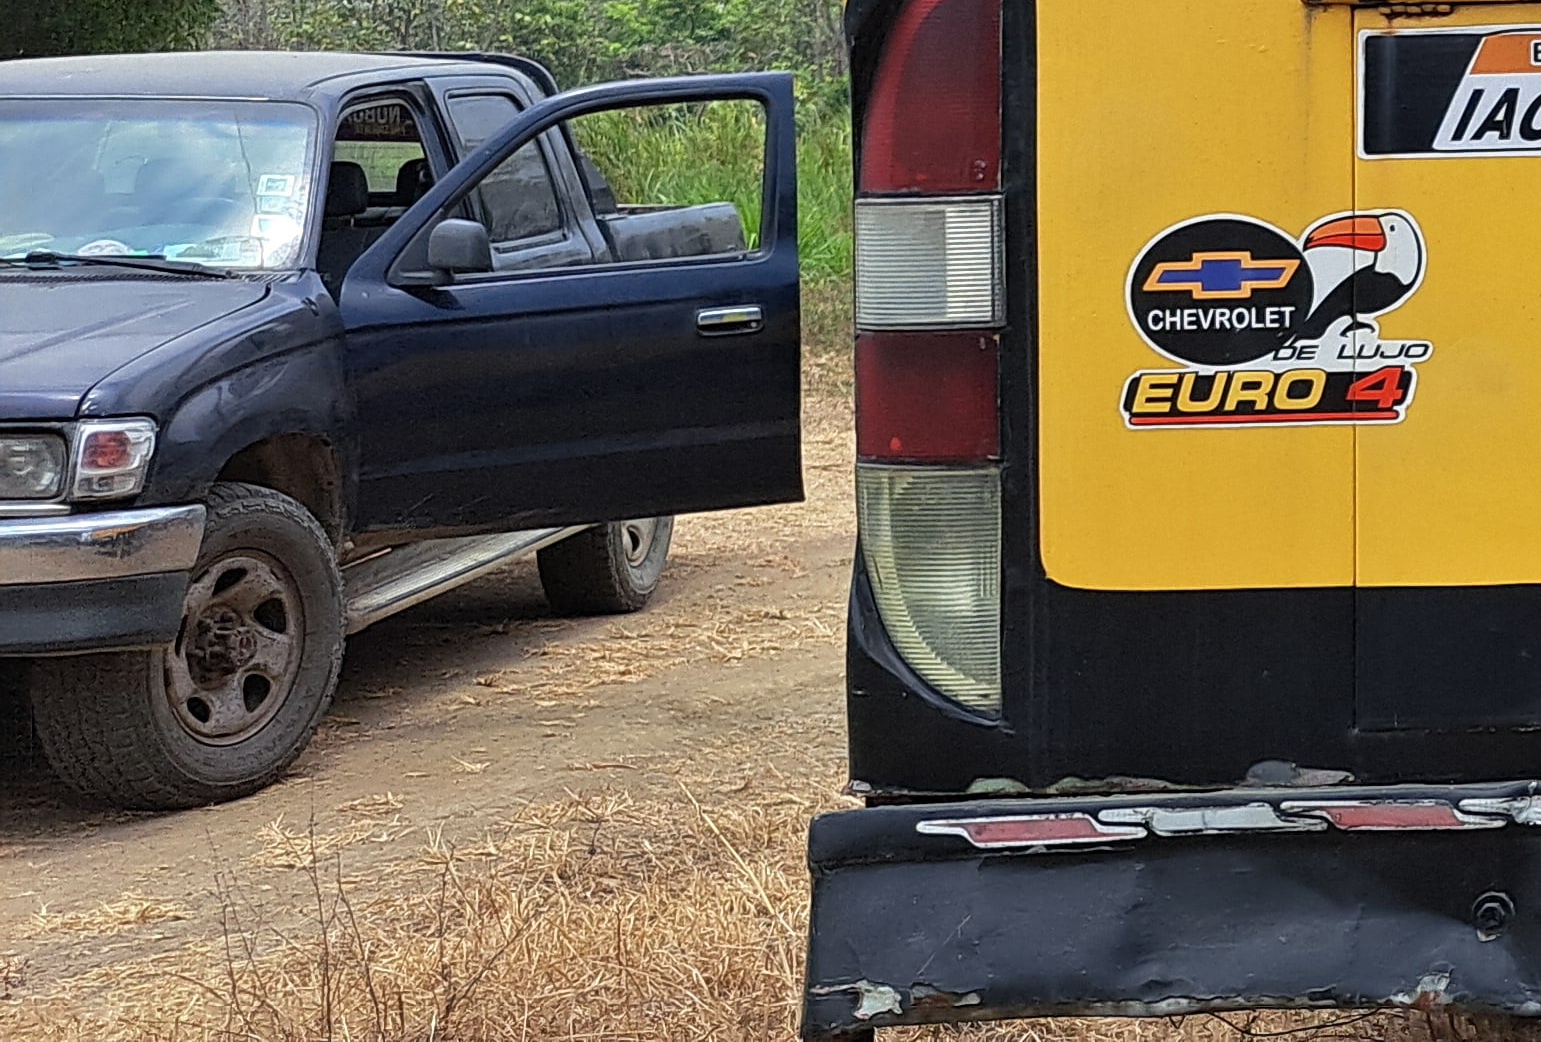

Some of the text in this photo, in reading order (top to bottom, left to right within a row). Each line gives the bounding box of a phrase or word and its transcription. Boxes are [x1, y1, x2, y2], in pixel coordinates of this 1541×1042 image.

[1147, 306, 1295, 332] CHEVROLET
[1273, 343, 1429, 361] DE LUJO
[1131, 365, 1405, 413] EURO 4
